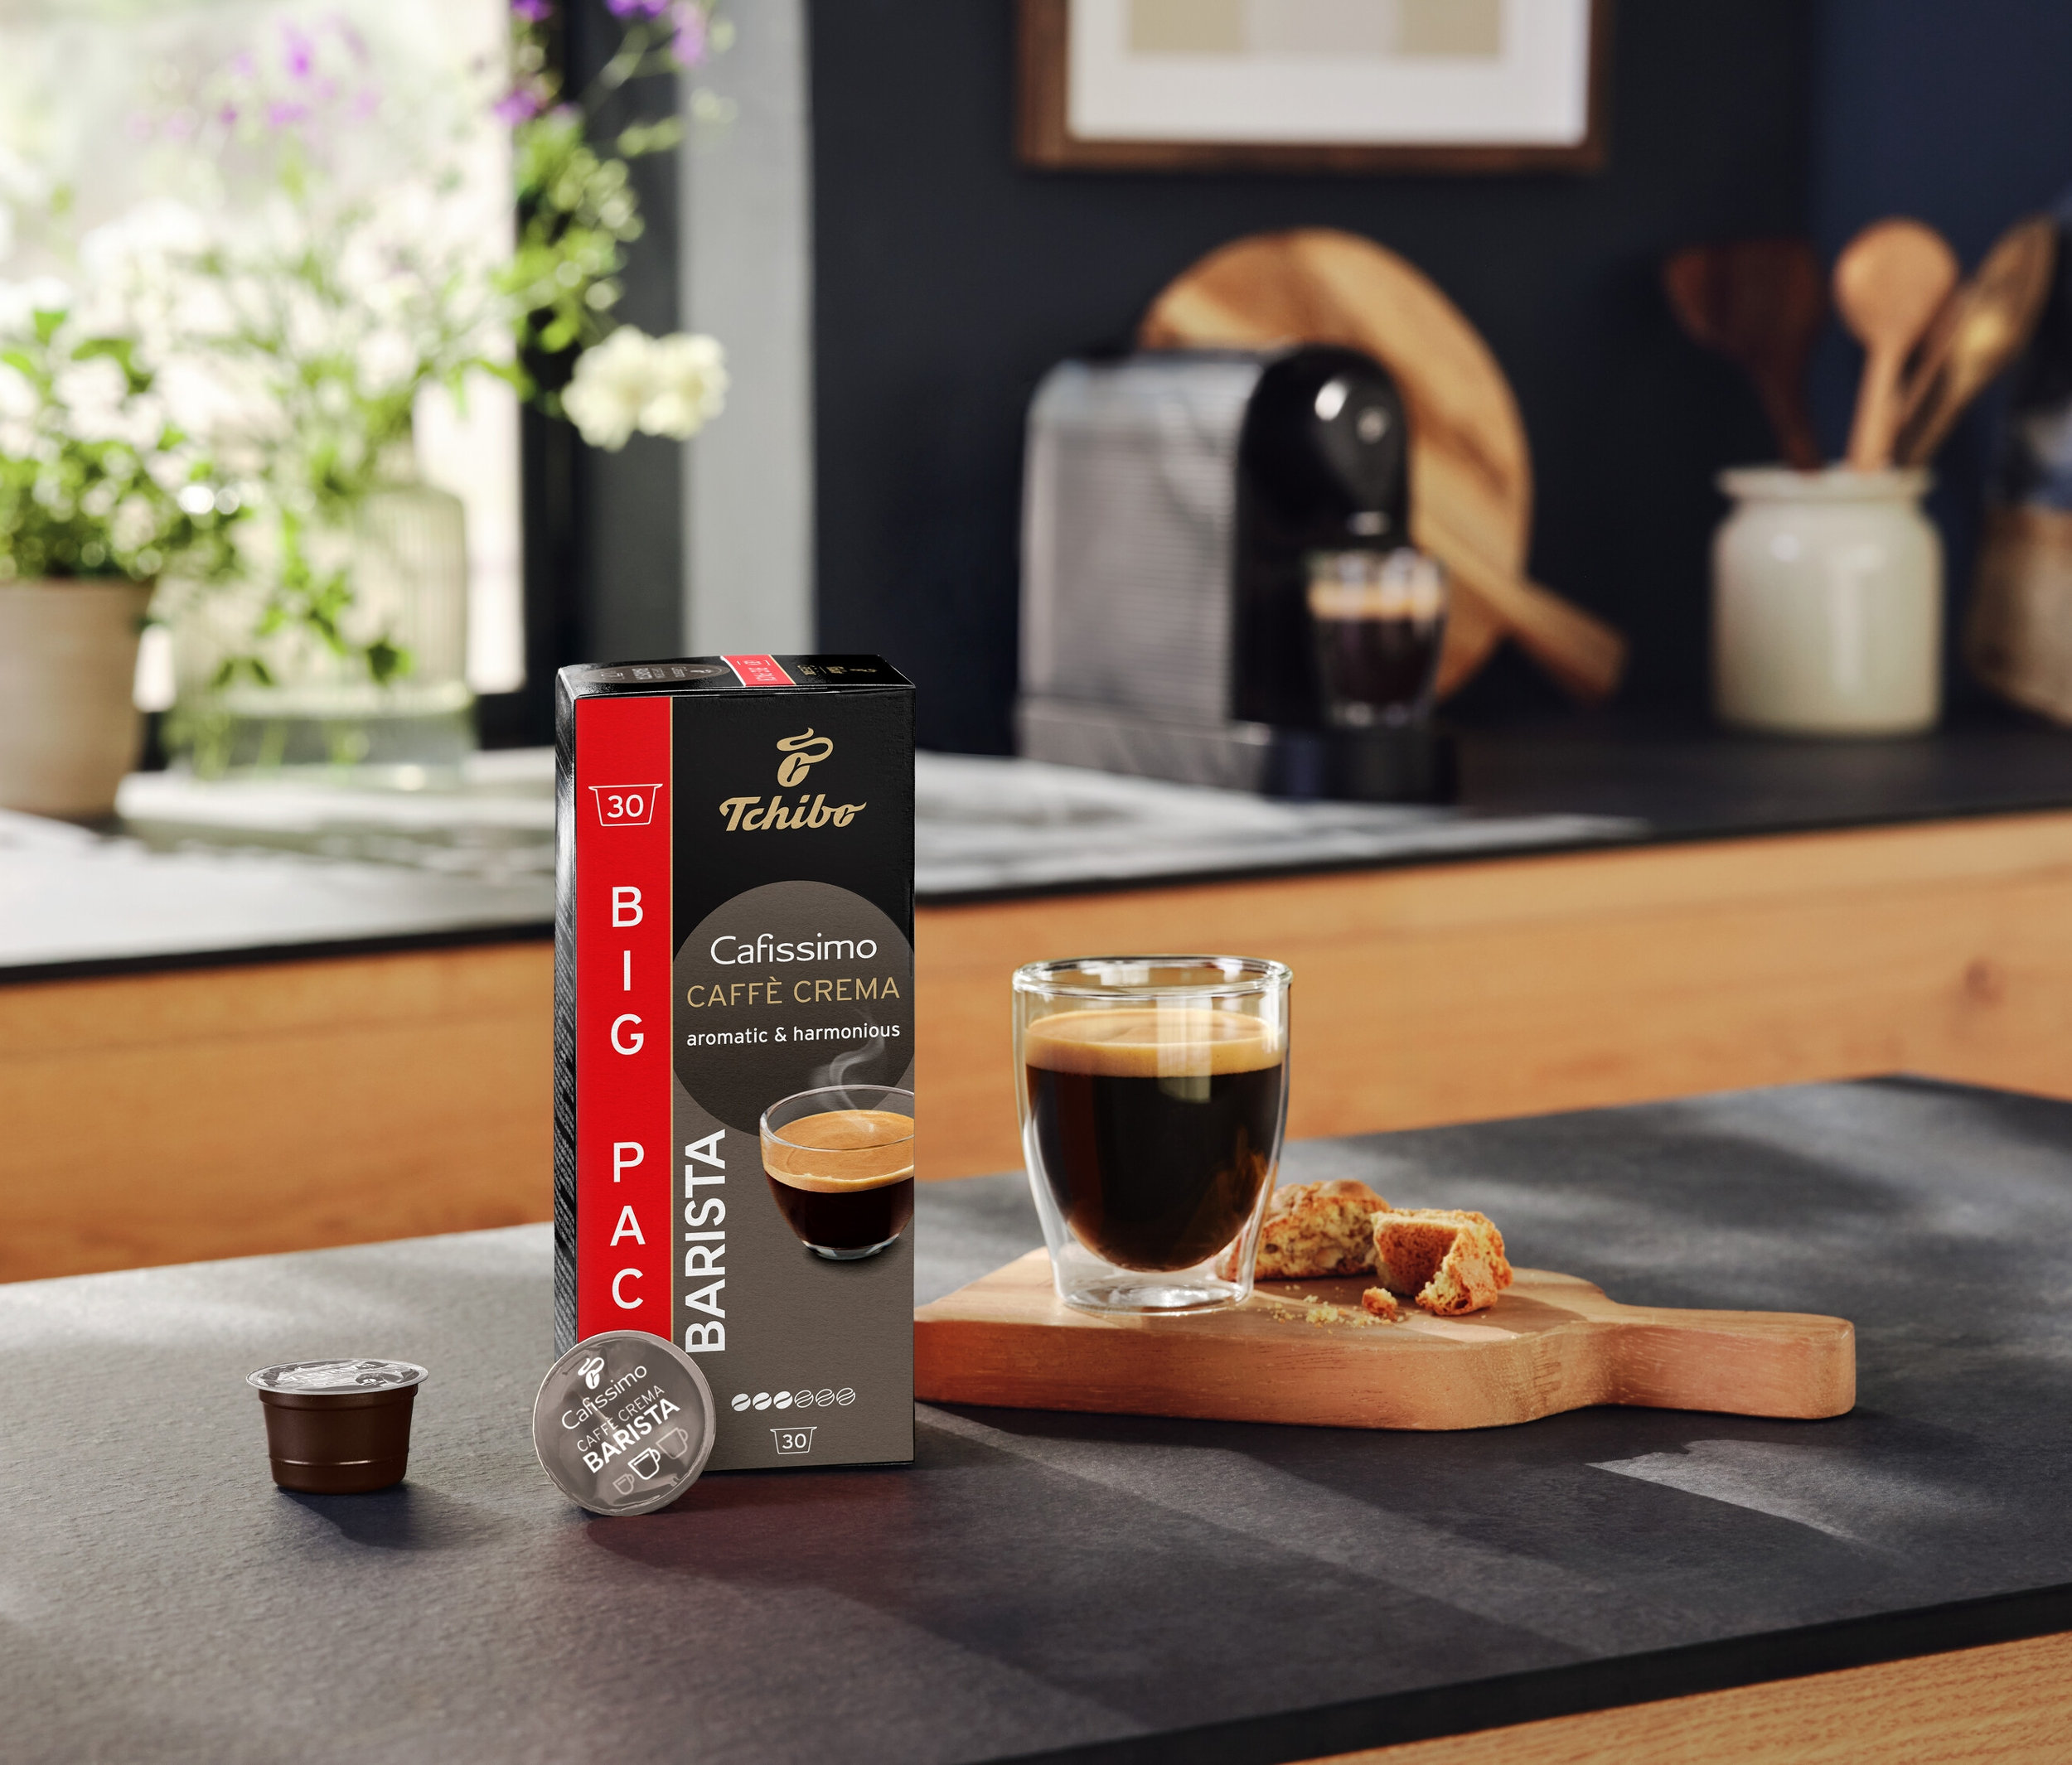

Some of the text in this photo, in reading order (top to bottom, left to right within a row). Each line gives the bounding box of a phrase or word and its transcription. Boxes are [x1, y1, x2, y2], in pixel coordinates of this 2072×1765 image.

[608, 795, 644, 818] 30
[719, 793, 867, 831] Tchibo
[710, 932, 878, 965] Cafissimo
[687, 976, 900, 1008] CAFFÈ CREMA
[686, 1023, 900, 1047] aromatic & harmonious
[684, 1129, 727, 1353] BARISTA
[561, 1365, 648, 1430] Cafissimo
[618, 1385, 666, 1422] CREMA
[582, 1397, 680, 1474] BARISTA
[782, 1433, 806, 1450] 30
